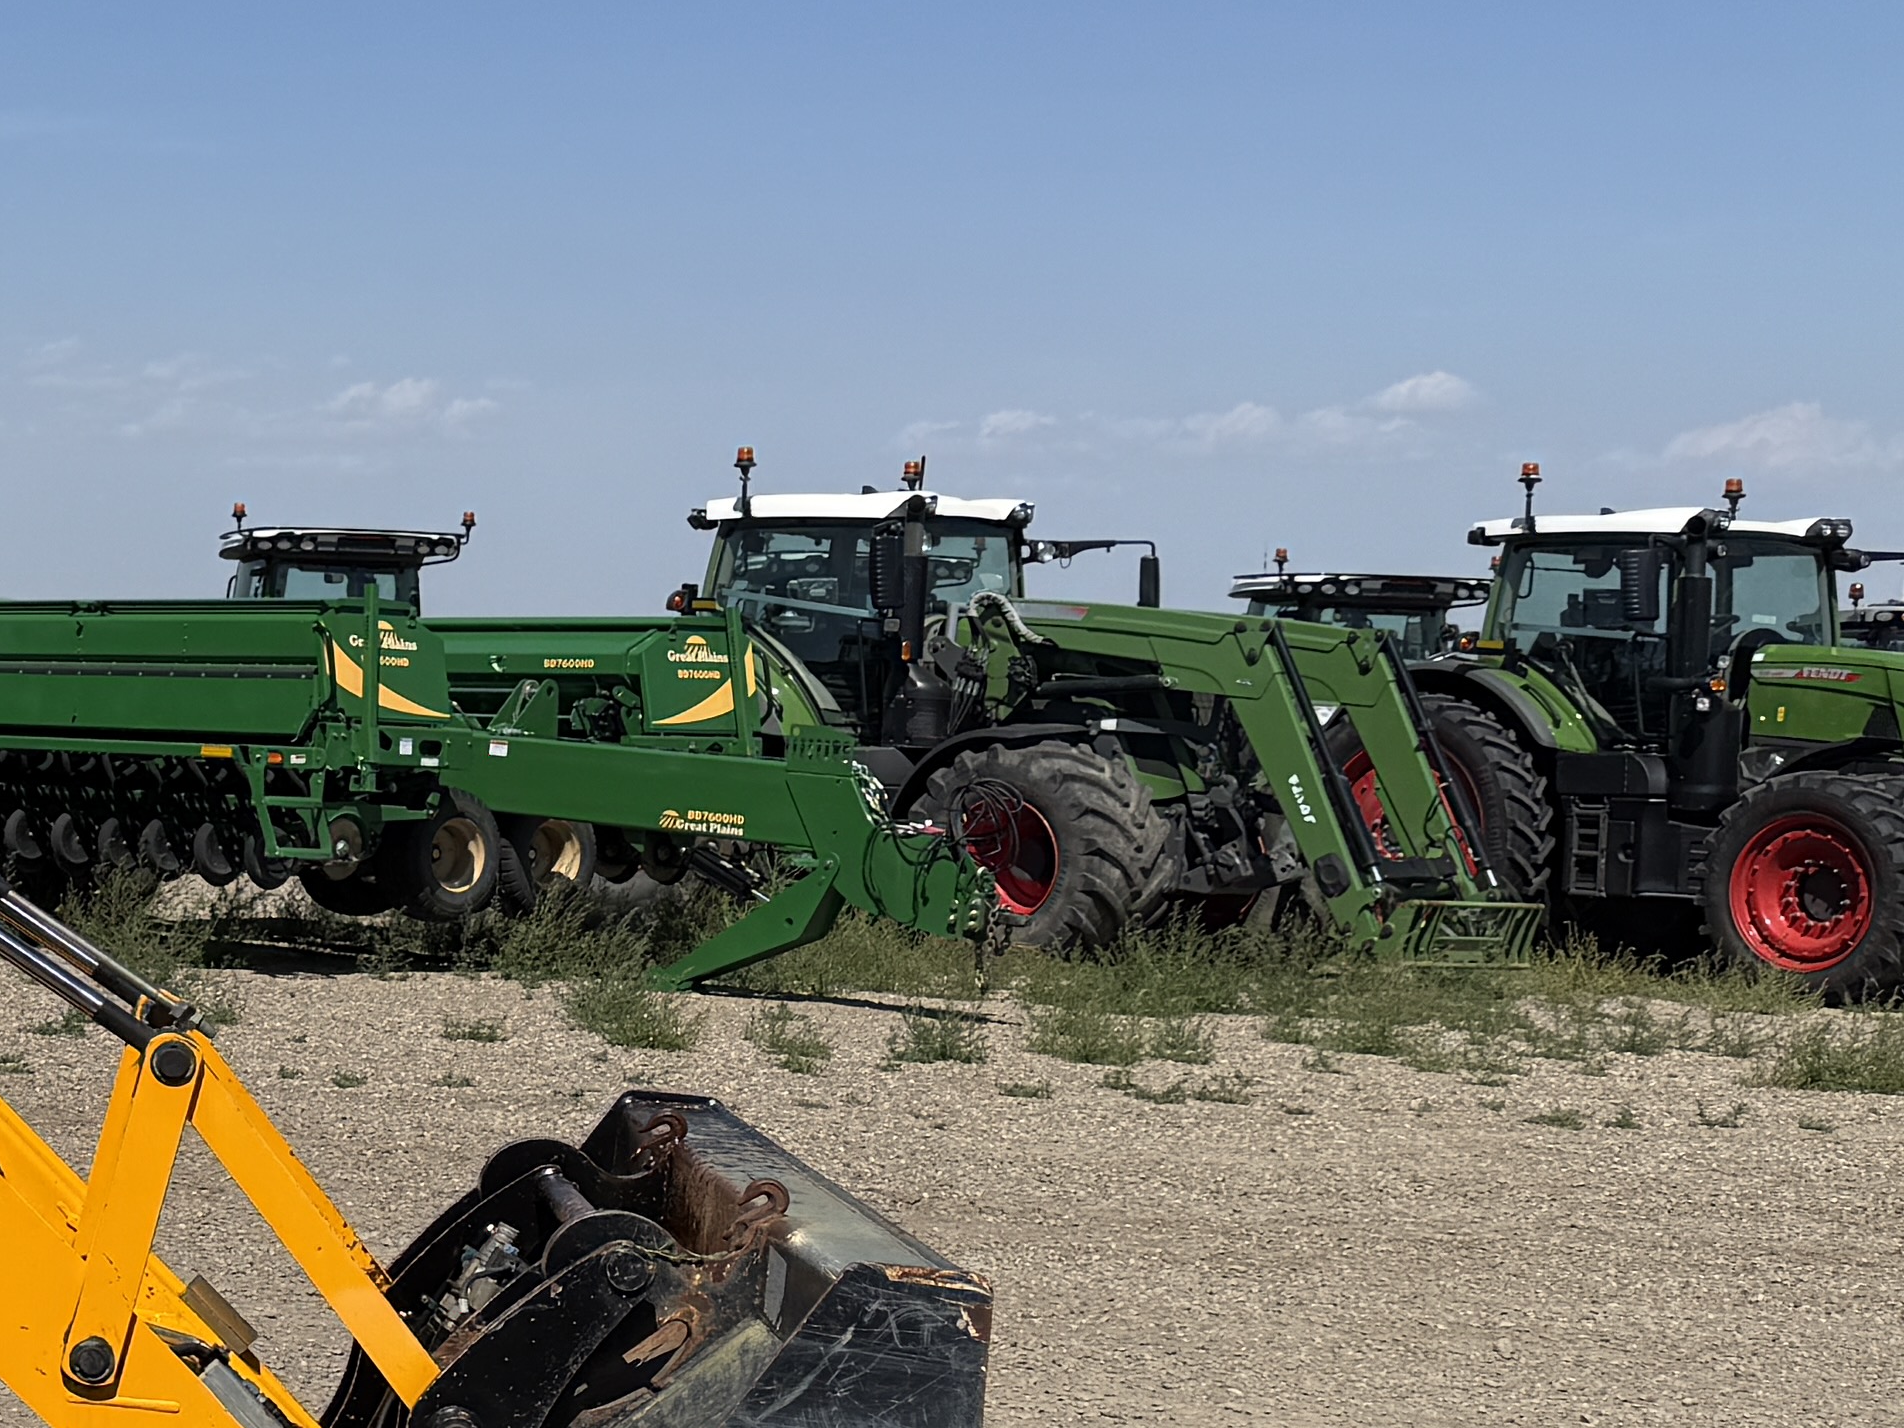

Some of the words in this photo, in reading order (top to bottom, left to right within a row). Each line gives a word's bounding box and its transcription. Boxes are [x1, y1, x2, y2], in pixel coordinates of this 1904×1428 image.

[1800, 666, 1853, 681] FENDT
[687, 809, 745, 825] BD7600HD
[675, 819, 708, 833] Great
[709, 821, 745, 836] Plains
